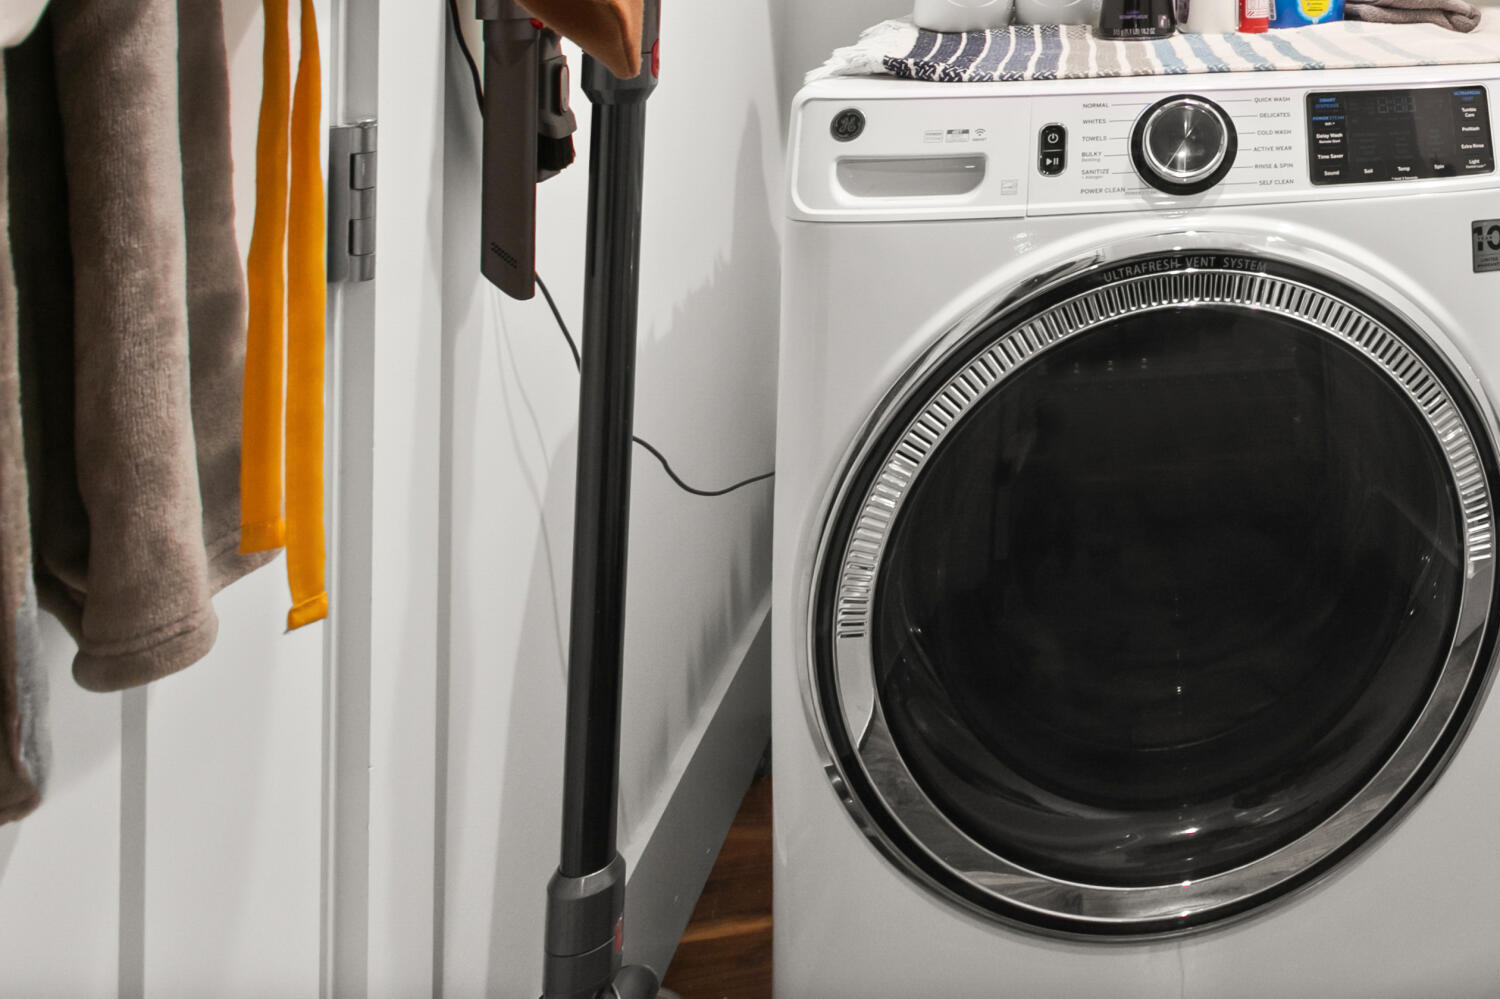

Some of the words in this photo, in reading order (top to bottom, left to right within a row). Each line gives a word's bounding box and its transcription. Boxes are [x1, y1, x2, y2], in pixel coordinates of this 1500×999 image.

[1103, 257, 1181, 282] ULTRAFRESH
[1185, 257, 1216, 268] VENT
[1223, 257, 1267, 271] SYSTEM
